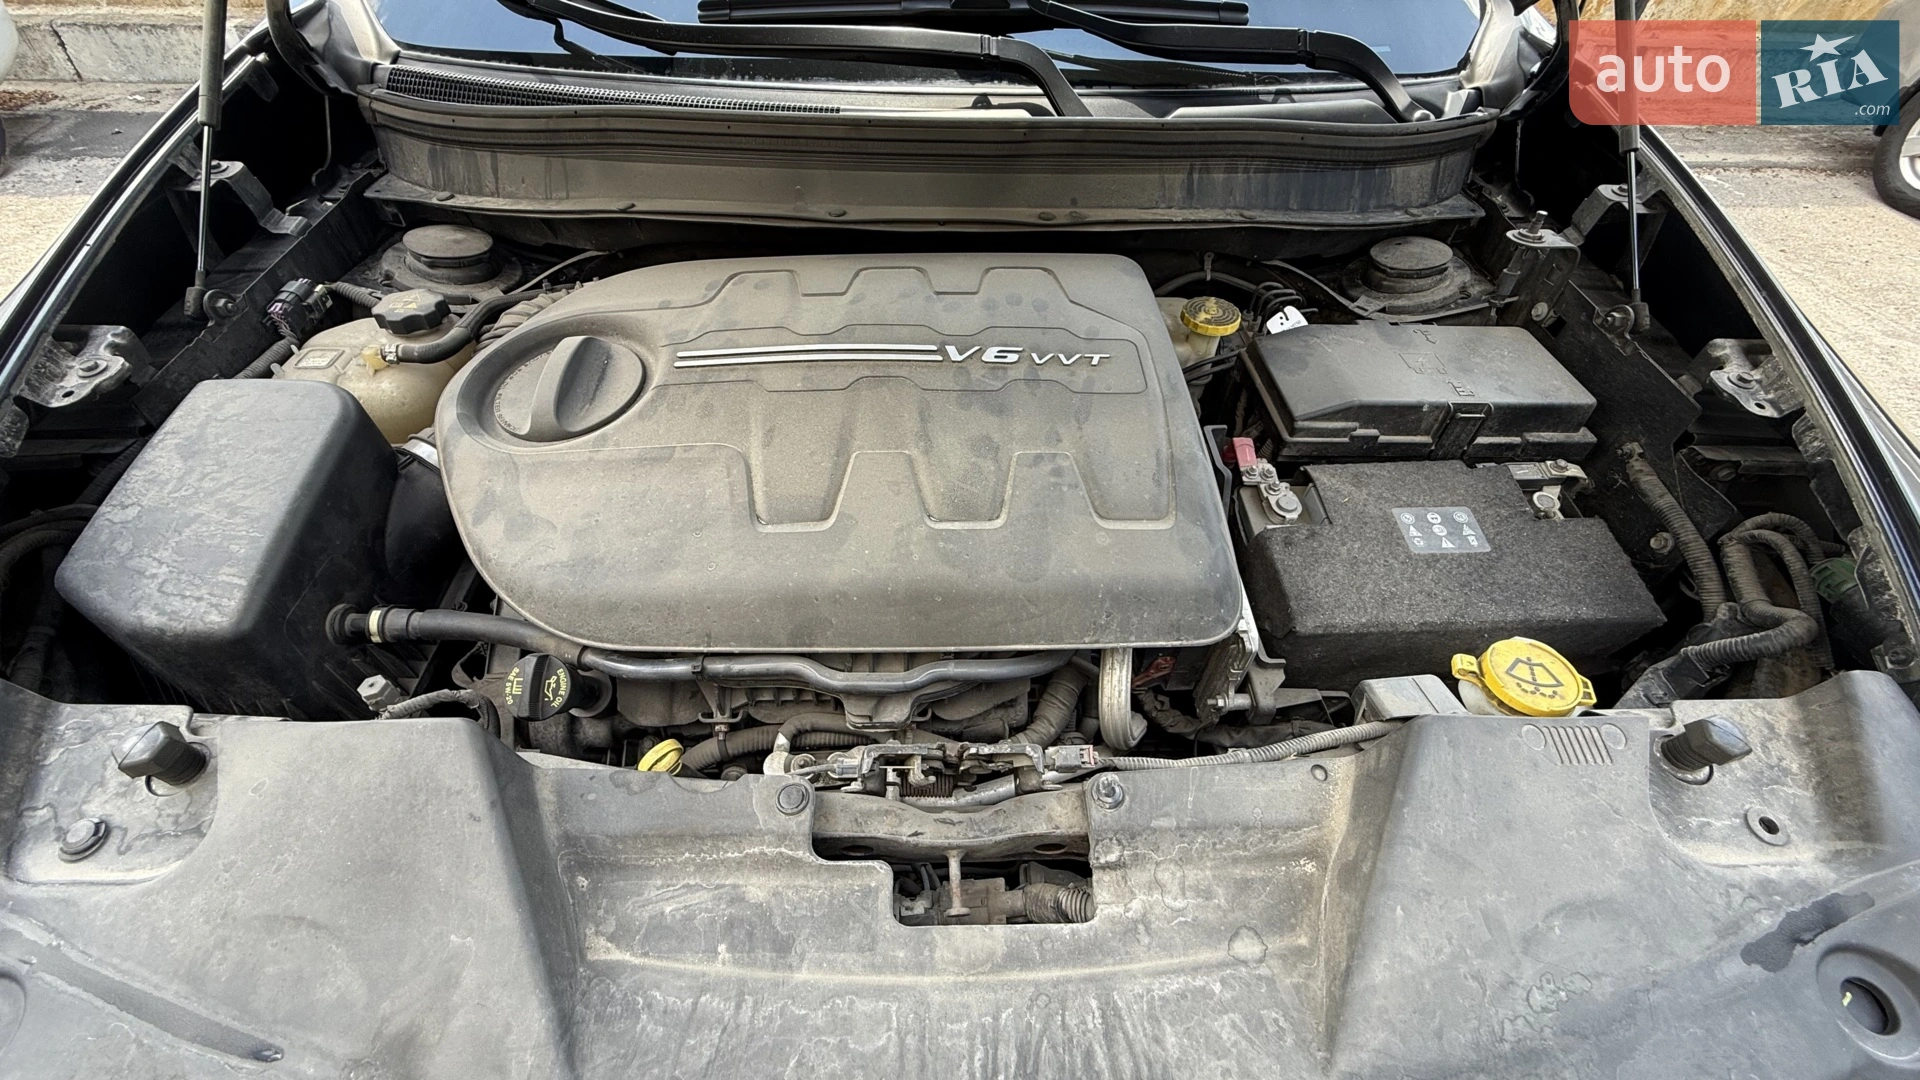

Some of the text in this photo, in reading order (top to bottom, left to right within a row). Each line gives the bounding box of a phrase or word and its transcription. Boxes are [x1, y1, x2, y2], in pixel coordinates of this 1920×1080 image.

[944, 345, 1111, 366] V6 VVT
[507, 667, 519, 681] SAE
[550, 668, 567, 708] ENGINE OIL
